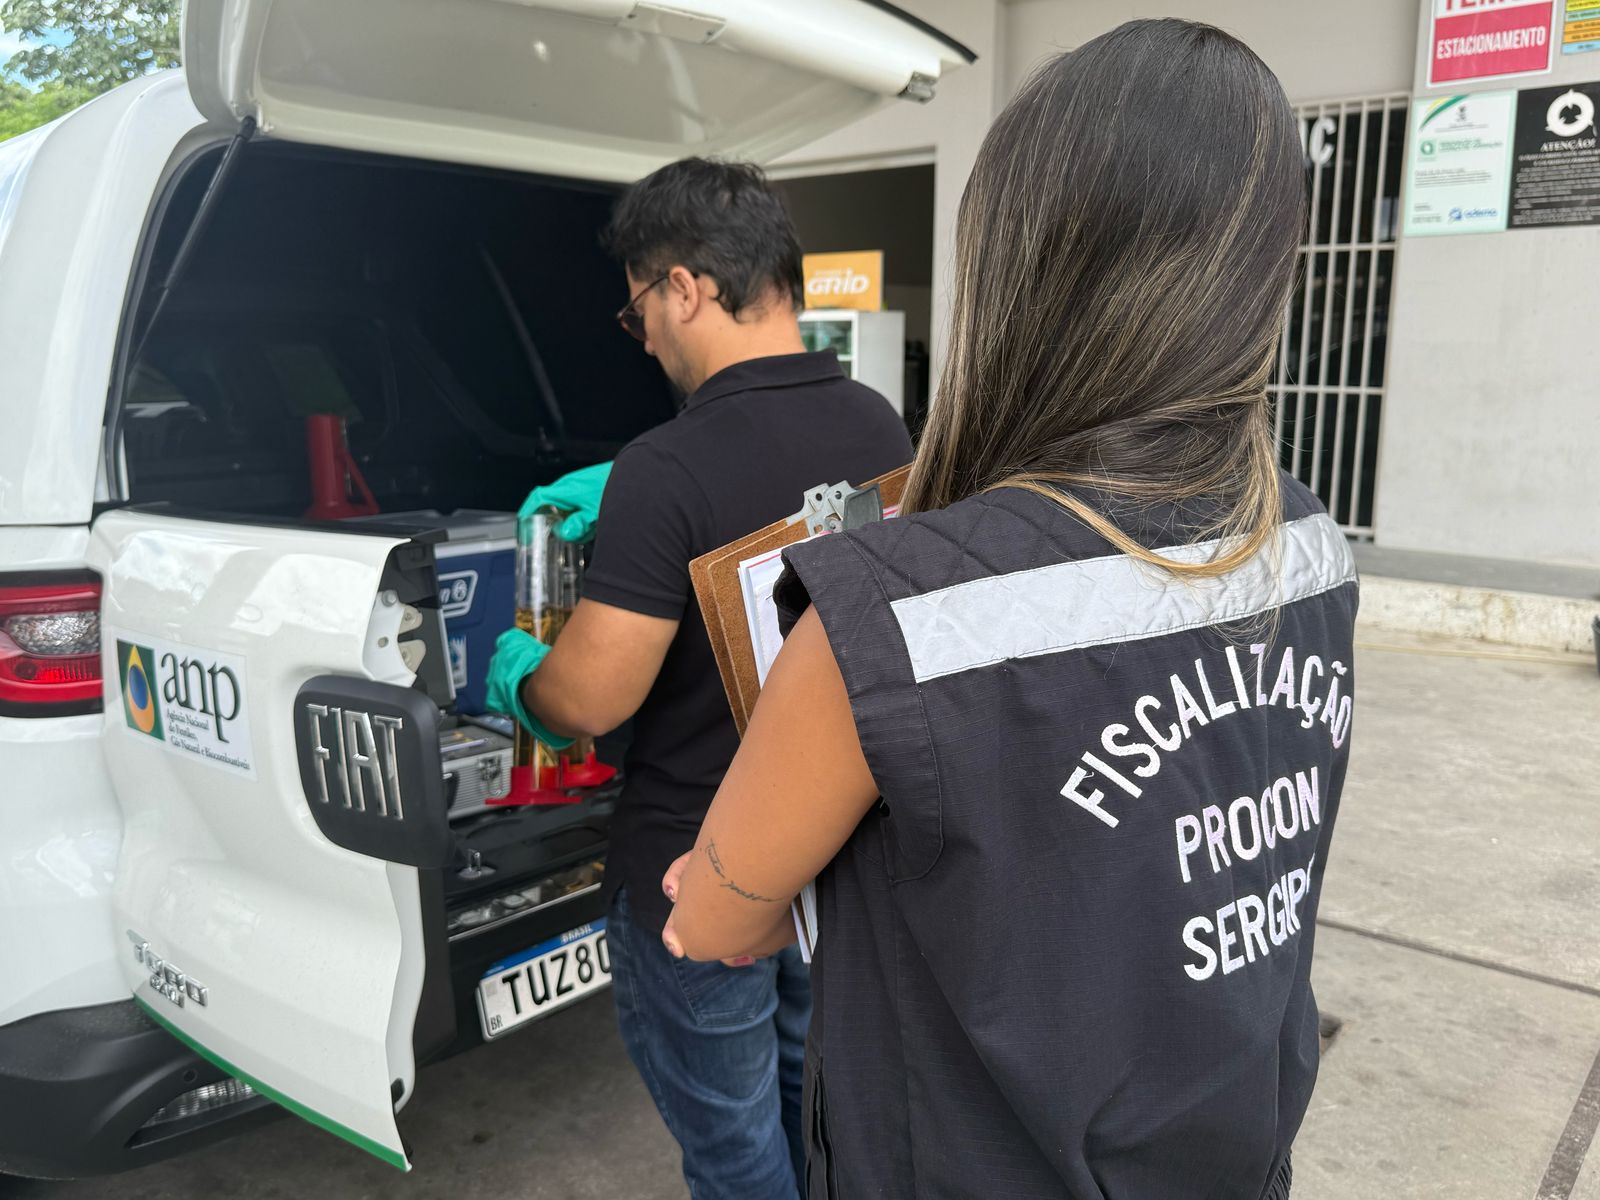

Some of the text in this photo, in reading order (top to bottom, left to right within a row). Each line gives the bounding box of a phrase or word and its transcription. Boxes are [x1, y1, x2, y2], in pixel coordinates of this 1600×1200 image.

[1436, 26, 1547, 60] ESTACIONAMENTO
[161, 652, 241, 743] anp
[1060, 643, 1352, 828] FISCALIZAÇÃO
[306, 703, 403, 820] FIAT
[1175, 766, 1321, 884] PROCON
[561, 923, 593, 944] BRASIL
[490, 1016, 503, 1030] BR
